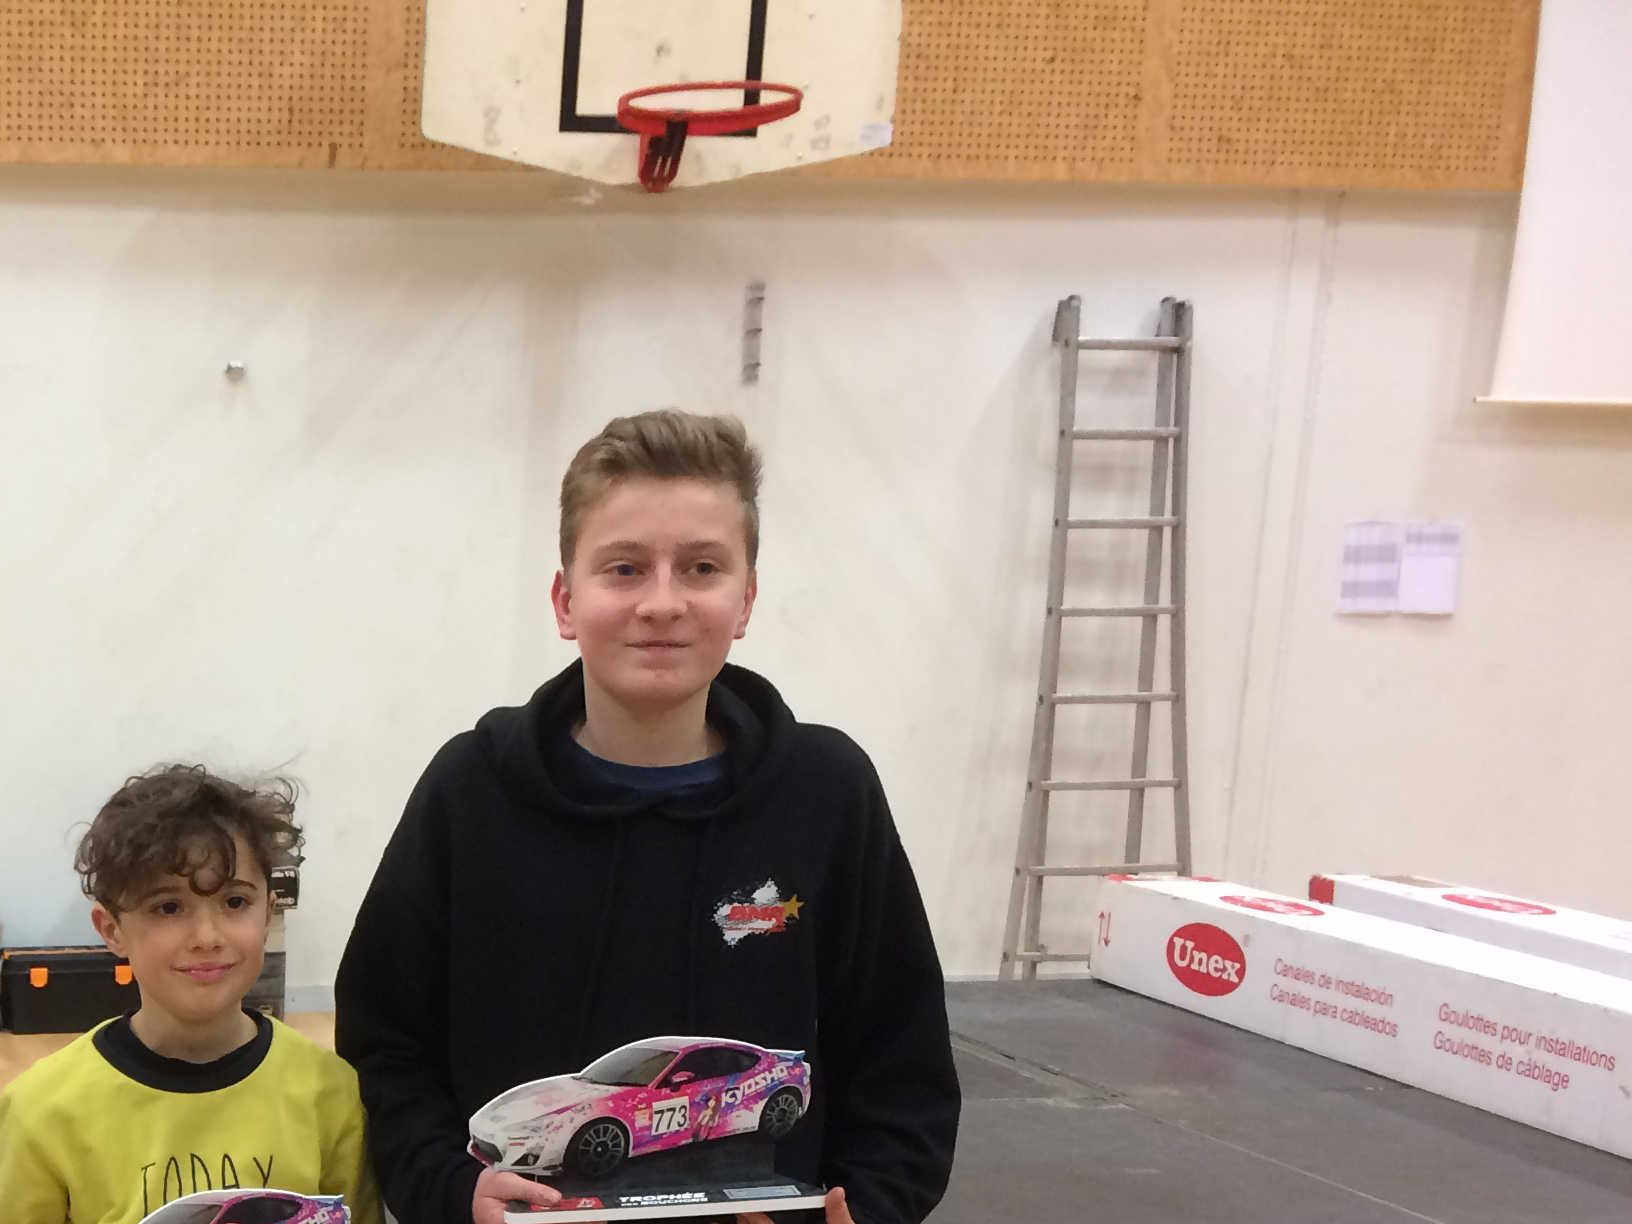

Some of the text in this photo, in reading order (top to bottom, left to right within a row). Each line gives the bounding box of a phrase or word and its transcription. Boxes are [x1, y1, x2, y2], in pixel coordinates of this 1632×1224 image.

[1172, 936, 1241, 984] Unex
[1274, 958, 1316, 985] Canales
[1318, 972, 1333, 990] de
[1270, 983, 1399, 1038] Canales para cableados
[1433, 1031, 1493, 1067] Goulottes
[1496, 1051, 1513, 1072] de
[1438, 1002, 1616, 1072] Goulottes pour installations
[653, 1105, 688, 1133] 773
